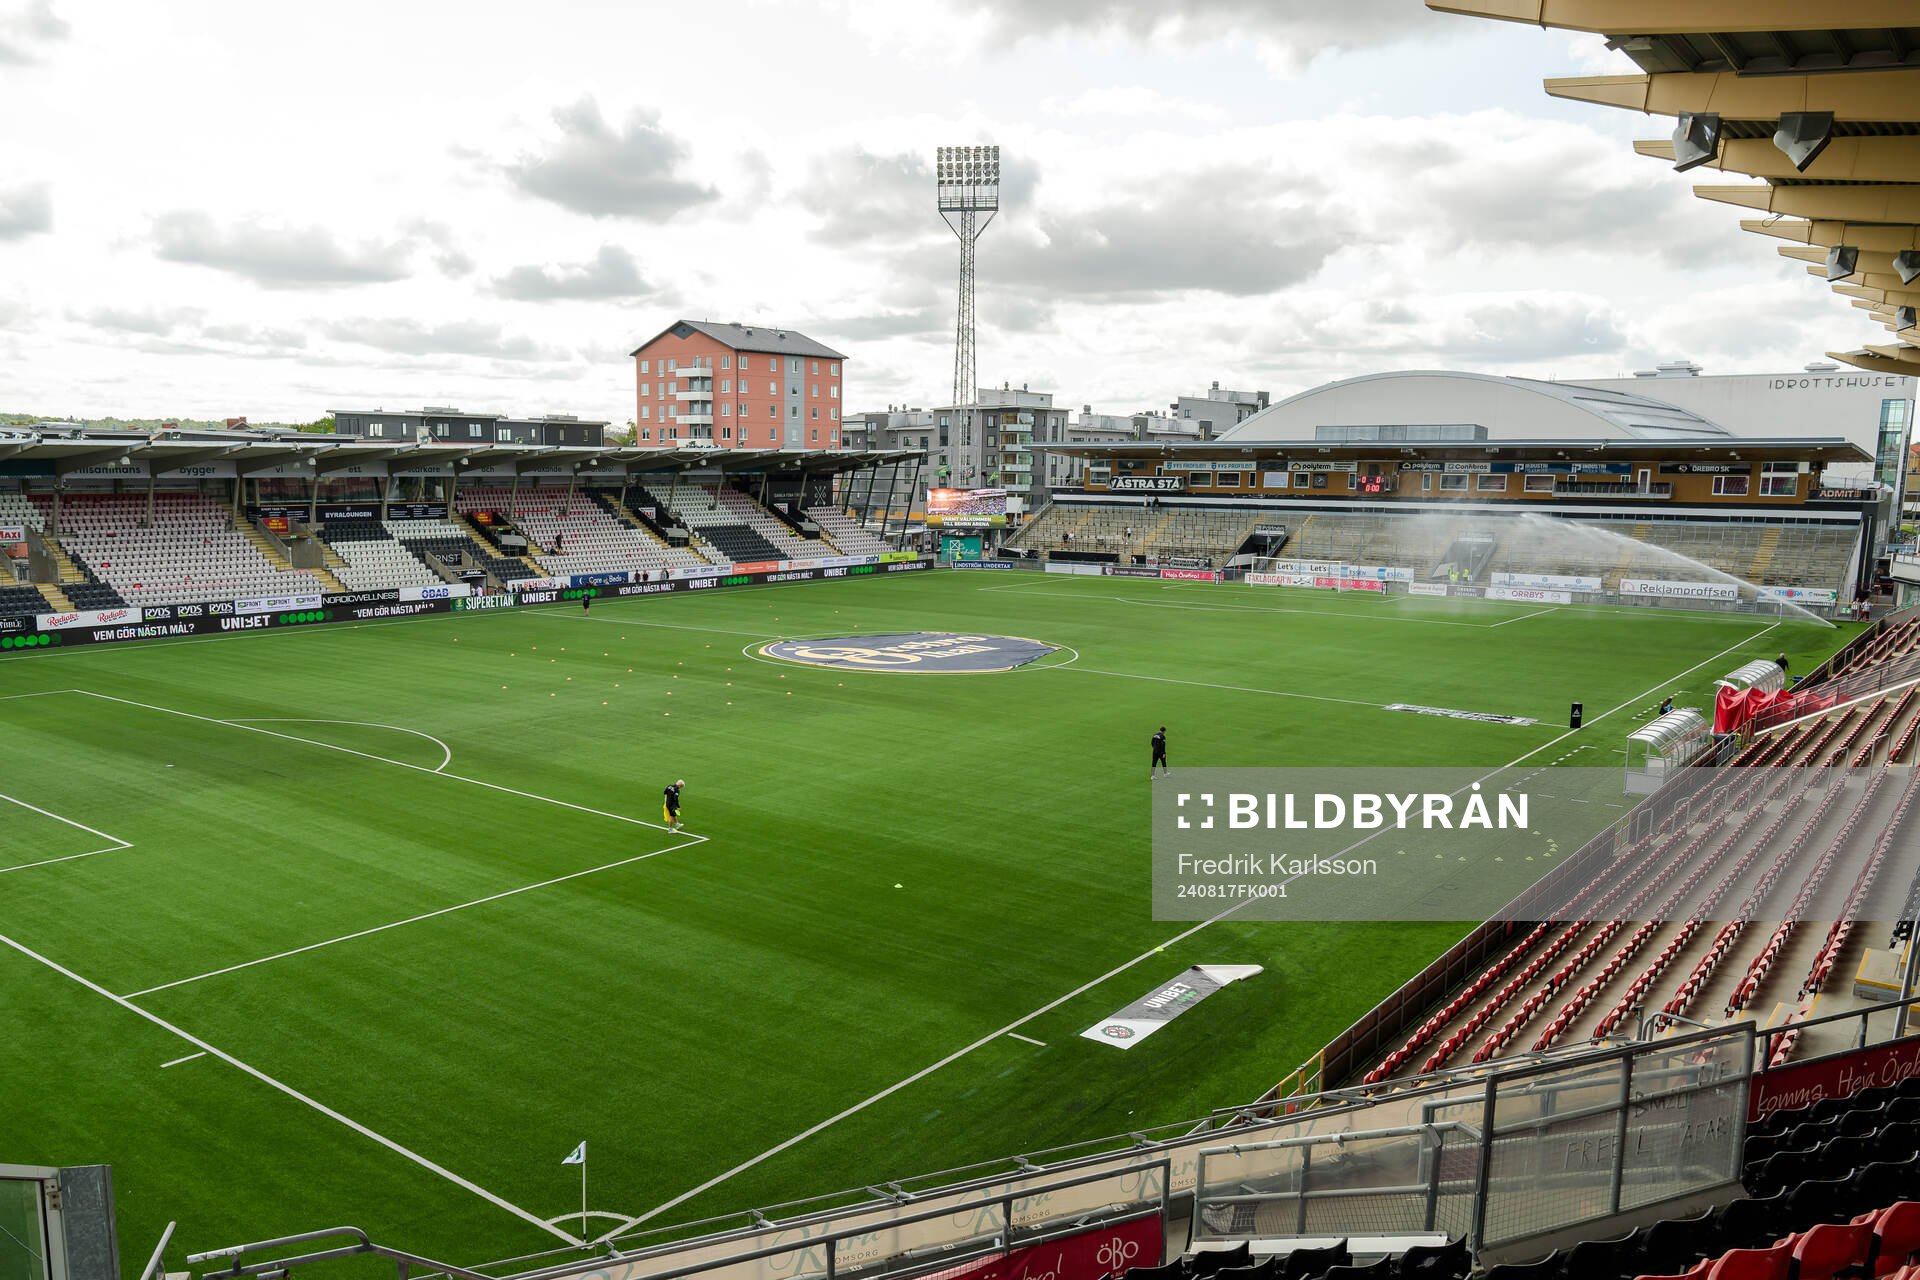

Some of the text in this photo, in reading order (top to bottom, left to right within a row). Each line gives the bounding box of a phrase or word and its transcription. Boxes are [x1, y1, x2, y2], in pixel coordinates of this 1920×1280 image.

[1769, 376, 1910, 390] IDROTTSHUSET
[1302, 463, 1331, 471] polyterm
[1110, 476, 1156, 489] VÄSTRA
[1819, 490, 1854, 498] ADMIT
[824, 567, 848, 578] UNIBET
[1310, 564, 1327, 572] Let's
[619, 581, 675, 595] VEM GÖR NÄSTA MÅL?
[689, 578, 718, 589] UNIBET
[521, 591, 558, 603] UNIBET
[1511, 590, 1545, 600] ORRBYS
[1639, 583, 1735, 598] Reklamproffsen
[208, 602, 234, 613] RYDS
[465, 594, 514, 611] SUPERETTAN
[145, 608, 171, 618] RYDS
[177, 605, 202, 615] RYDS
[356, 608, 374, 618] VEM
[374, 605, 390, 616] GÖR
[390, 603, 414, 615] NÄSTA
[220, 614, 271, 630] UNIBET
[93, 621, 196, 641] VEM GÖR NÄSTA MÅL?
[1143, 981, 1193, 1009] UNIBET
[1757, 1085, 1829, 1115] komma.
[1838, 1062, 1876, 1095] Heja
[1170, 1177, 1197, 1188] OMSO
[1011, 1209, 1051, 1225] OMSORG
[834, 1248, 879, 1265] OMSORG
[1096, 1237, 1139, 1270] ÖBO
